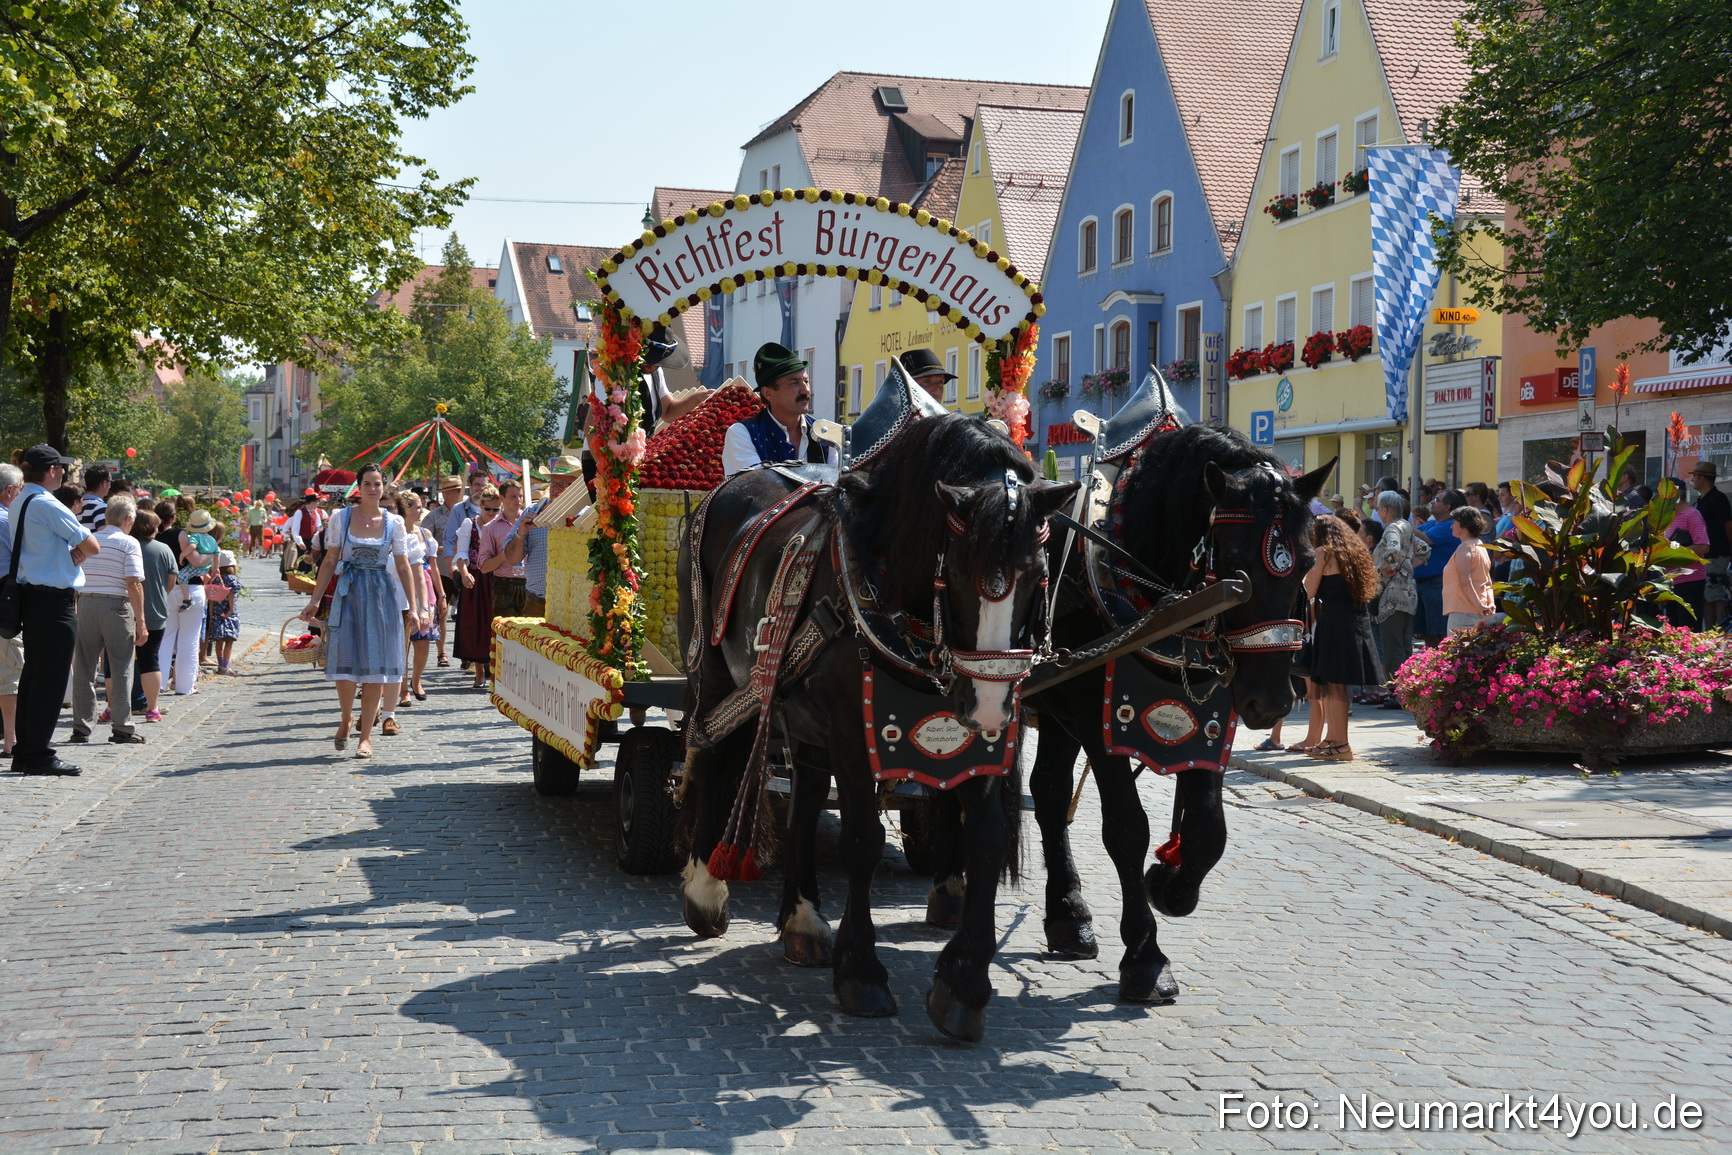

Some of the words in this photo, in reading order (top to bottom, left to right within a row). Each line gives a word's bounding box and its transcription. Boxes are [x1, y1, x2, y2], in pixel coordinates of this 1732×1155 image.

[634, 210, 785, 303] Richtfest
[815, 209, 1011, 326] Bürgerhaus
[1440, 311, 1461, 322] KINO
[880, 331, 903, 354] HOTEL
[907, 327, 933, 347] Lehmeier
[1205, 334, 1221, 349] CAFÉ
[1582, 353, 1592, 390] P
[1434, 389, 1455, 404] RIALTO
[1457, 387, 1472, 401] KINO
[1484, 360, 1494, 423] KINO
[1520, 386, 1535, 400] DER
[1256, 415, 1269, 442] P
